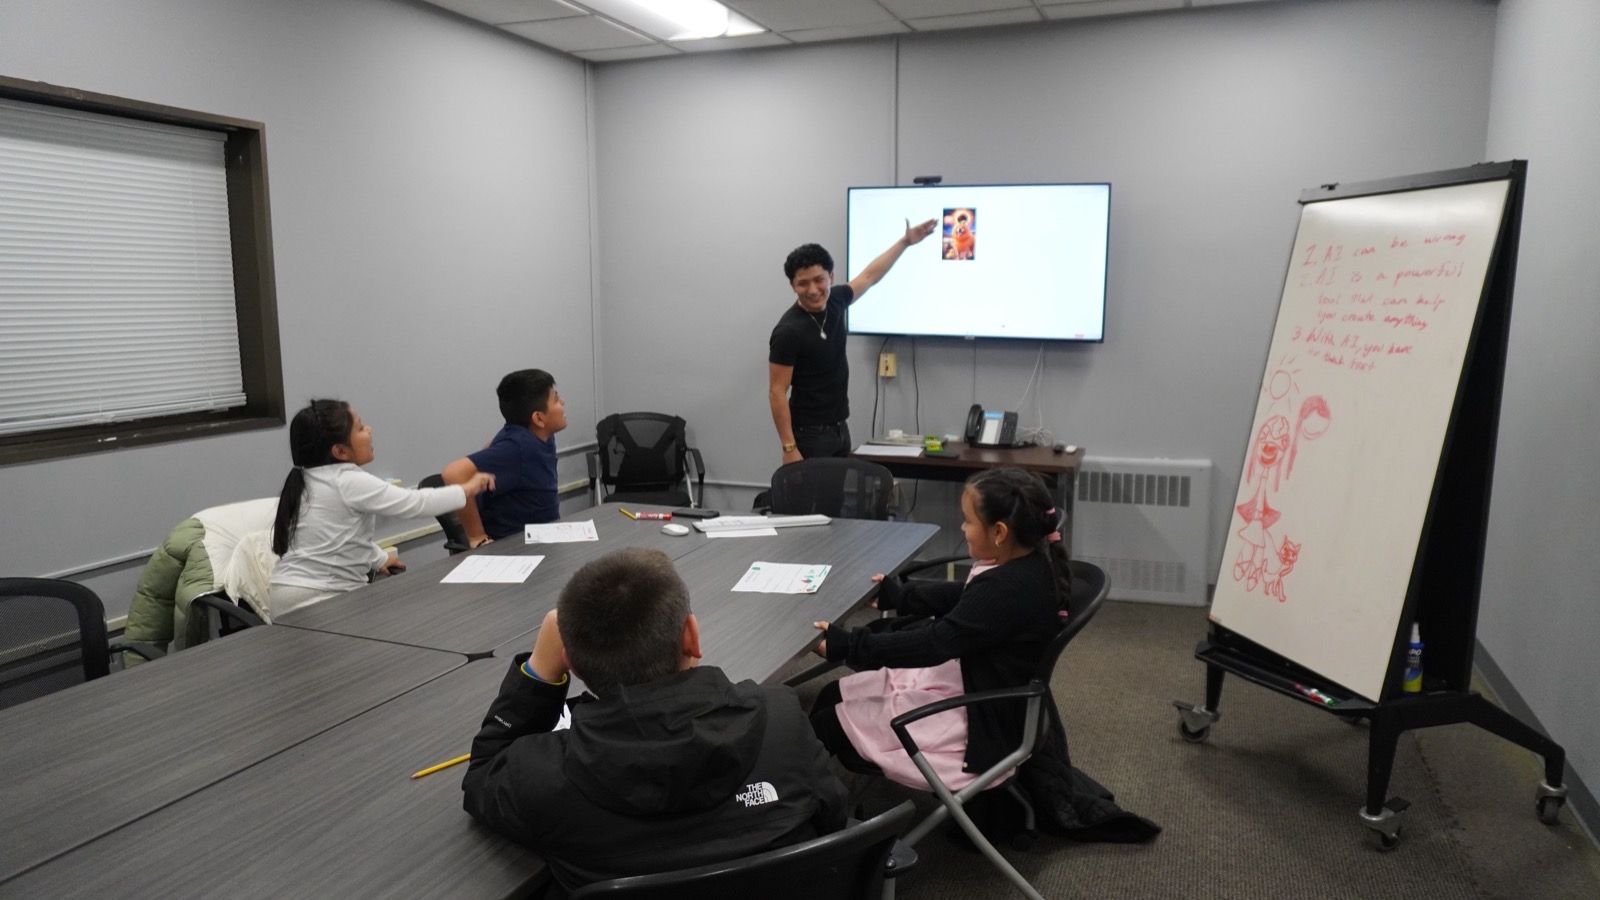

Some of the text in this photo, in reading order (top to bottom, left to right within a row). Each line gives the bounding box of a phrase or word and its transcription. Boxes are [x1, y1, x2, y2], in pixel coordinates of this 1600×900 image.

[1323, 244, 1344, 263] AI
[1353, 246, 1376, 257] can
[1391, 235, 1408, 248] be
[1424, 233, 1466, 247] wrong
[1316, 265, 1338, 287] AI
[1350, 270, 1362, 283] is
[1375, 272, 1388, 281] a
[1393, 260, 1465, 288] powerful
[1318, 293, 1340, 304] tool
[1382, 298, 1408, 306] can
[1415, 293, 1446, 312] help
[1317, 310, 1428, 332] you create anything
[1305, 326, 1335, 347] With
[1362, 342, 1385, 358] you
[1388, 342, 1414, 355] have
[735, 789, 763, 803] NORTH
[745, 782, 762, 793] THE
[744, 797, 765, 808] FACE
